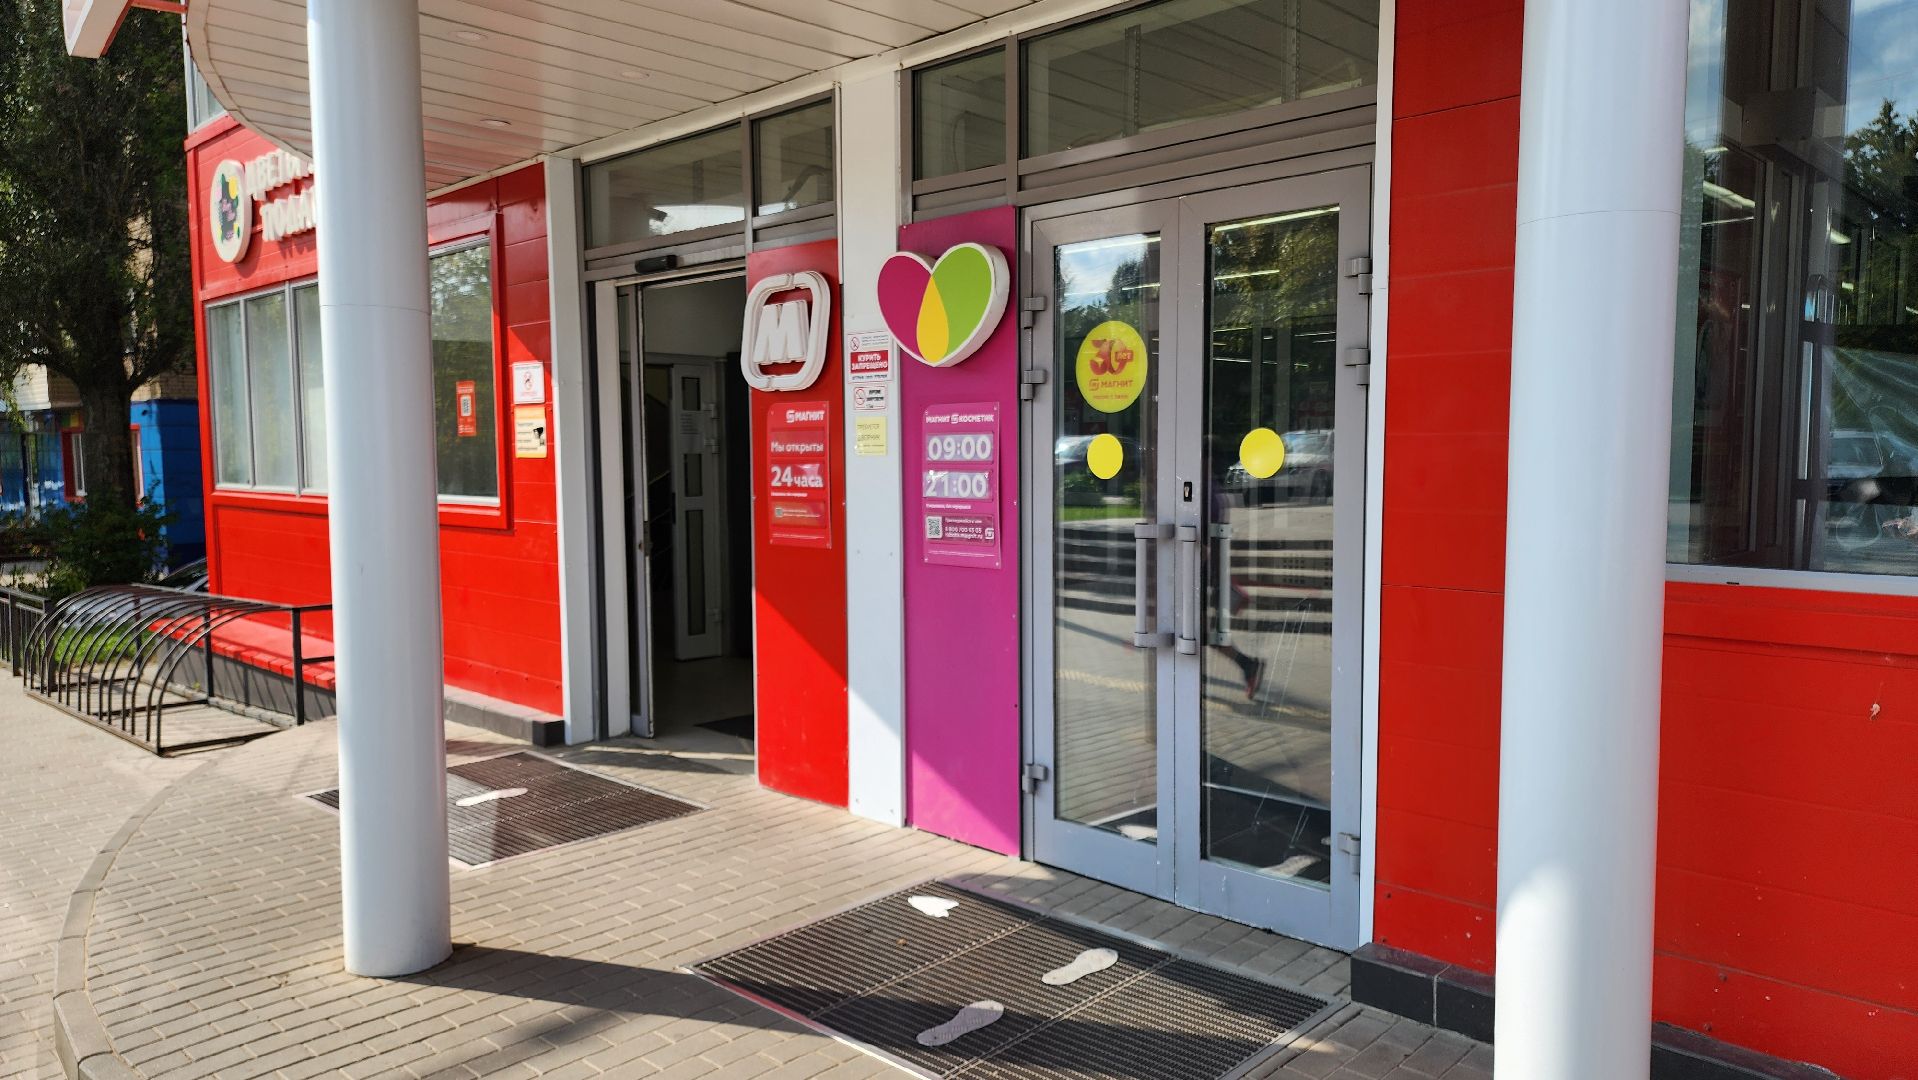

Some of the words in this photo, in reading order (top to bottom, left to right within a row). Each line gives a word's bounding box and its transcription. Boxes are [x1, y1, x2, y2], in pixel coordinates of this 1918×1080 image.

[858, 354, 881, 362] КУРИТЬ
[852, 361, 888, 370] ЗАПРЕЩЕНО
[1101, 380, 1133, 388] МАГНИТ
[795, 410, 825, 421] МАГНИТ
[926, 415, 950, 423] МАГНИТ
[959, 414, 994, 423] КОСМЕТИК
[771, 441, 784, 452] Мы
[786, 443, 824, 454] открыты
[928, 435, 992, 461] 09:00
[771, 465, 793, 487] 24
[794, 475, 824, 488] часа
[925, 474, 987, 497] 21:00
